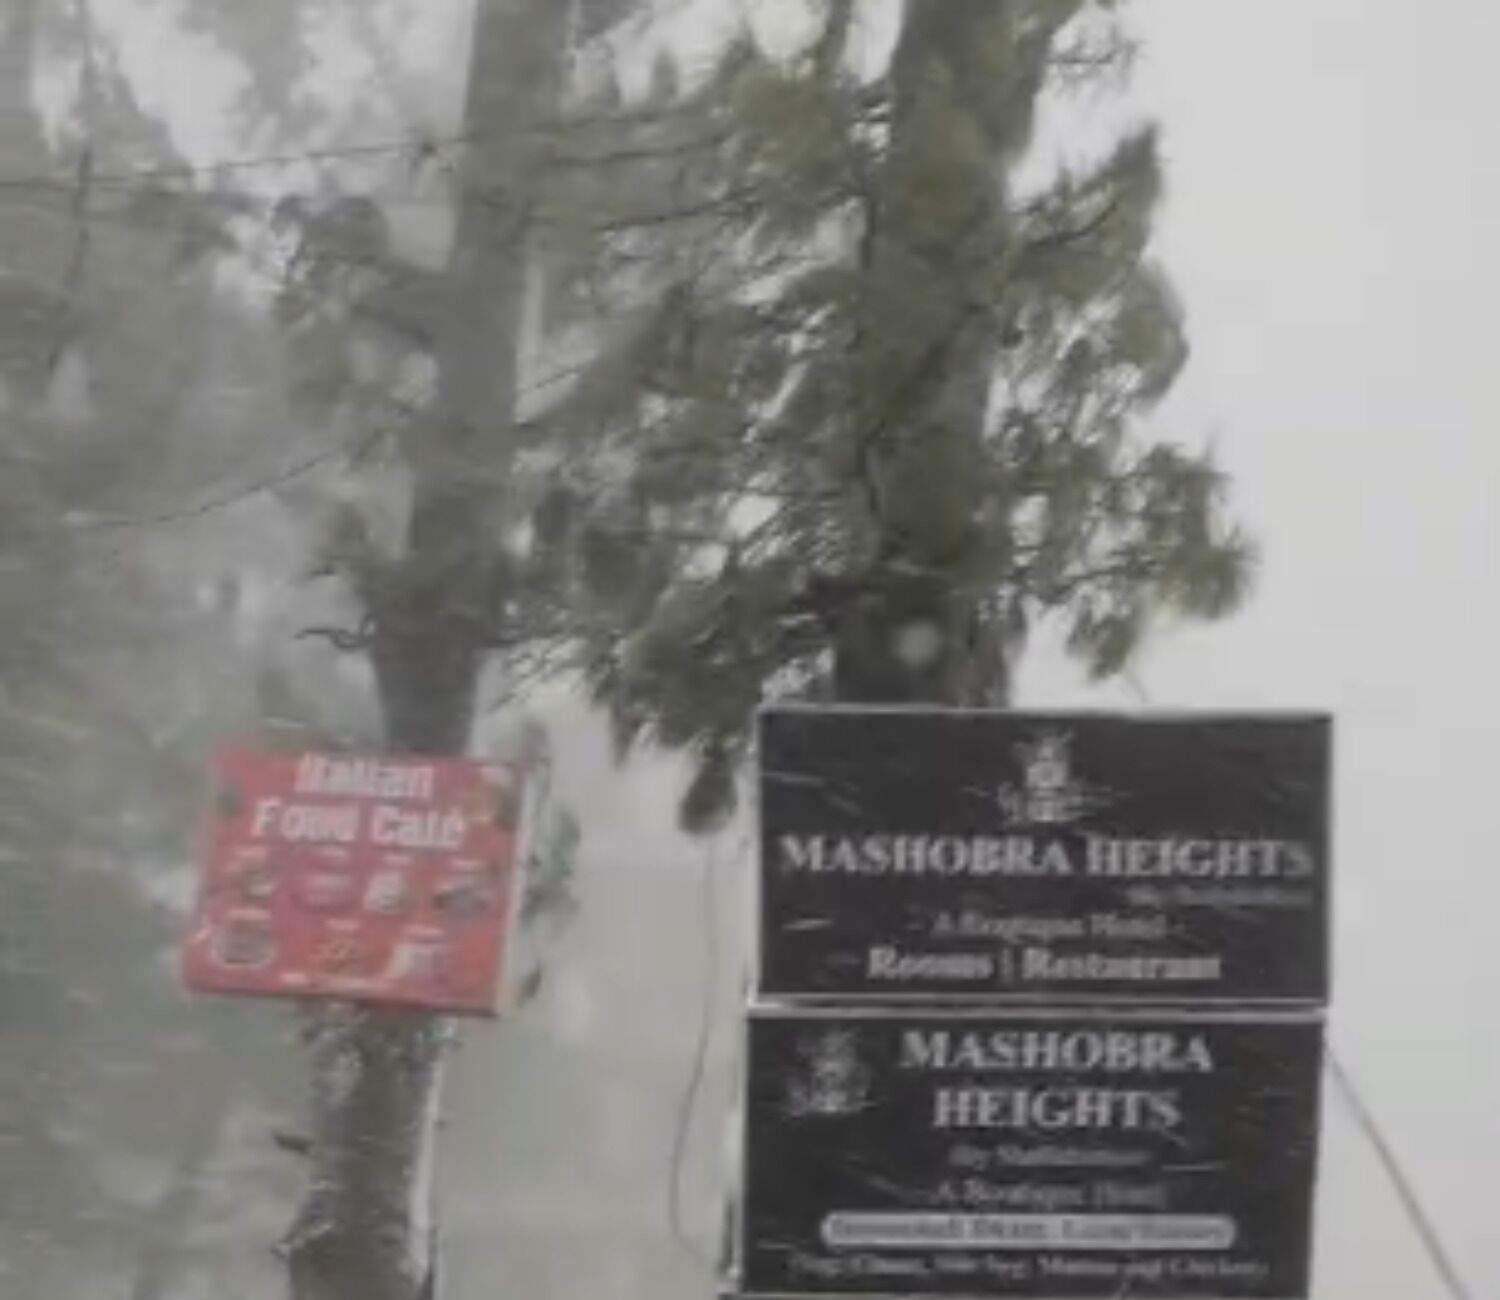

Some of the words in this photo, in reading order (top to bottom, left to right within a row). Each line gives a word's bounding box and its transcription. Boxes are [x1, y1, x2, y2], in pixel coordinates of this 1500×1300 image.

[780, 833, 1072, 877] MASHOBRA
[1084, 836, 1314, 878] HEIGHTS
[867, 946, 994, 981] Rooms
[1021, 946, 1222, 981] Restaurant
[899, 1030, 1213, 1072] MASHOBRA
[932, 1088, 1182, 1129] HEIGHTS
